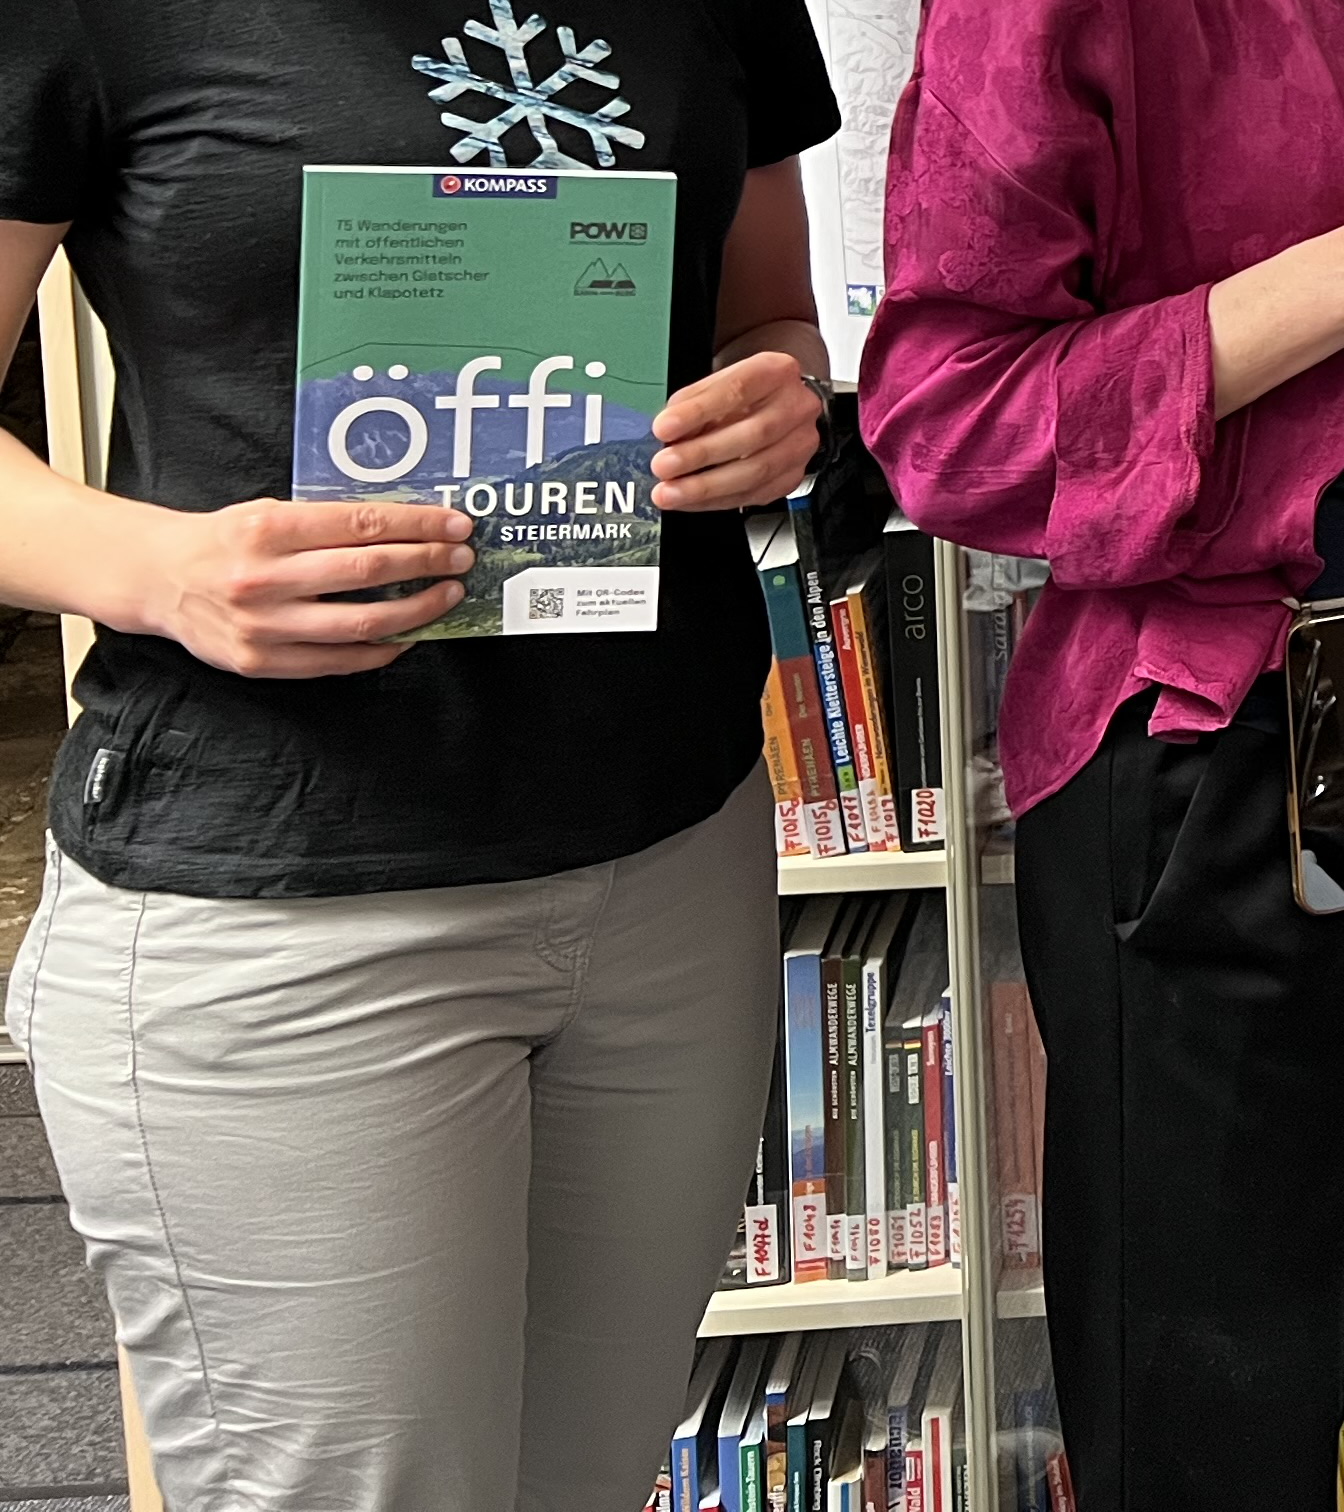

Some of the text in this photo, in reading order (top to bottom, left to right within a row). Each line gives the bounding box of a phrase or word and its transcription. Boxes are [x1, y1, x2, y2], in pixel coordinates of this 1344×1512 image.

[463, 177, 548, 194] KOMPASS
[357, 219, 468, 235] Wanderungen
[569, 221, 629, 240] POW
[334, 237, 360, 249] mit
[334, 253, 462, 266] Verkehrsmitteln
[334, 268, 489, 283] zwischen Gletscher
[333, 286, 445, 300] und Klapotetz
[327, 355, 606, 483] öffi
[433, 481, 636, 518] TOUREN
[500, 523, 633, 542] STEIERMARK
[806, 570, 823, 604] Alpen
[575, 608, 621, 617] Fahrplan
[811, 605, 825, 628] den
[902, 574, 926, 640] arco
[818, 643, 844, 718] Klettersteige
[835, 719, 850, 764] Leichte
